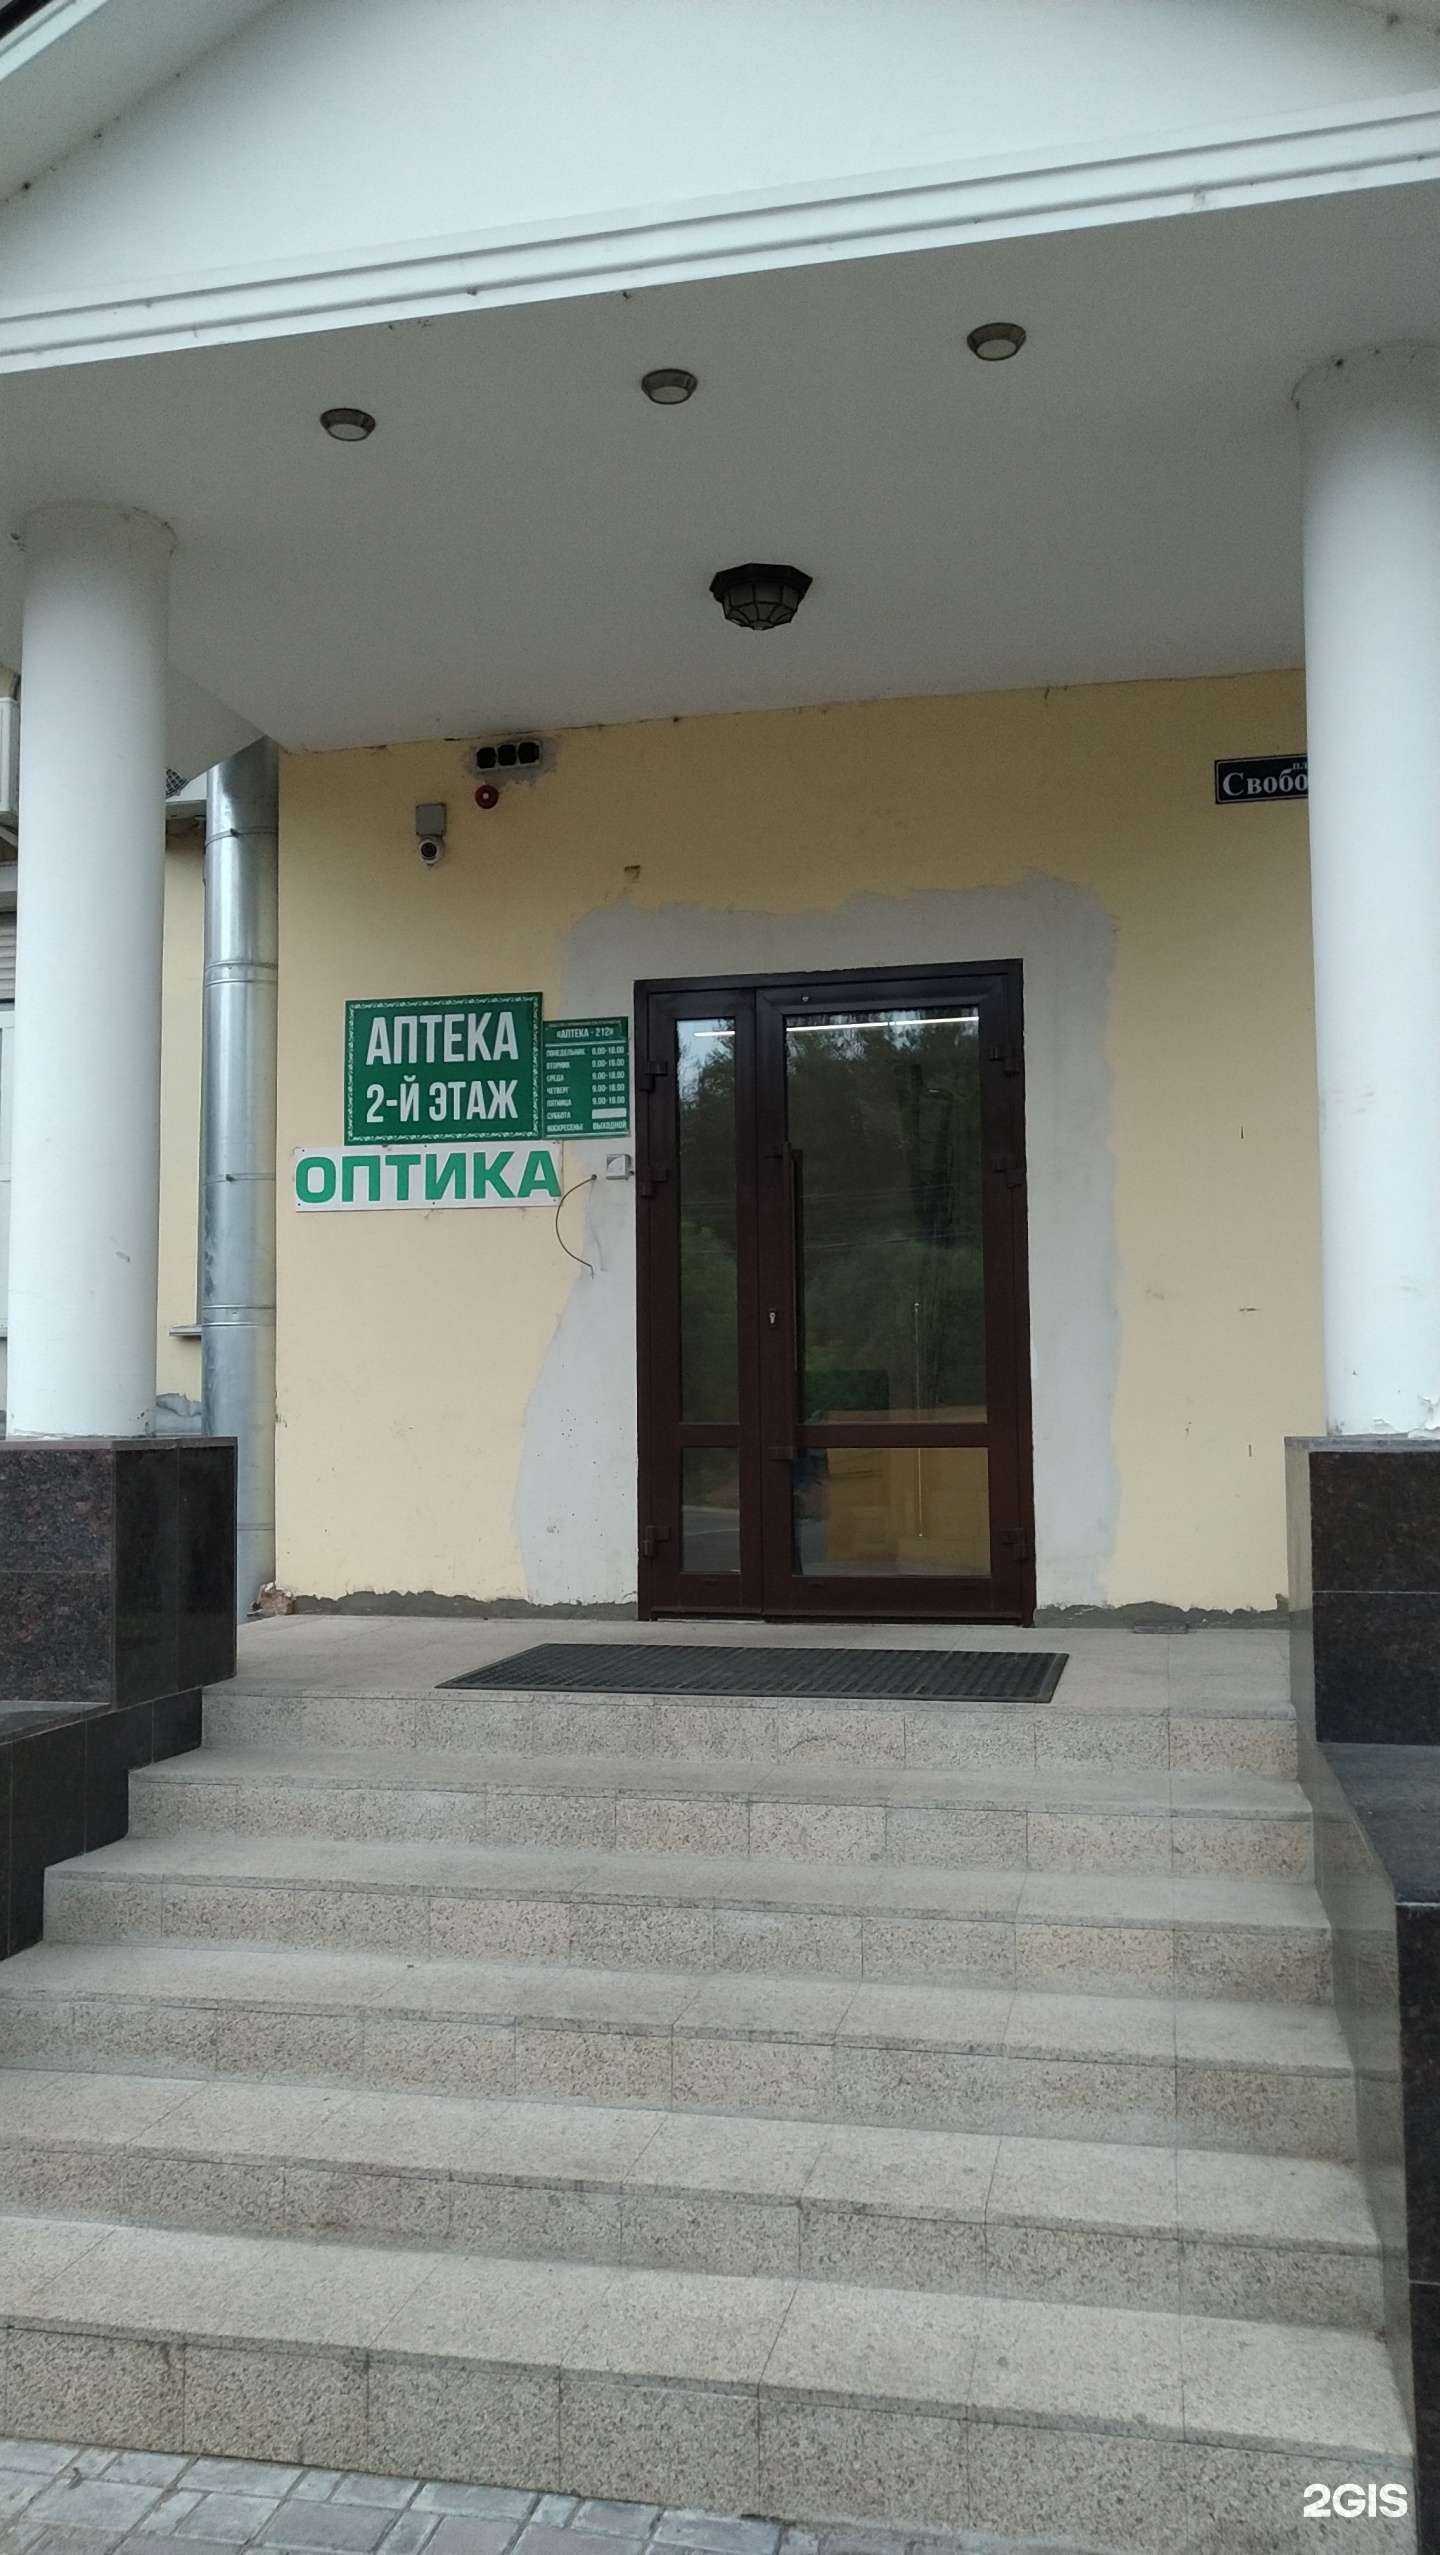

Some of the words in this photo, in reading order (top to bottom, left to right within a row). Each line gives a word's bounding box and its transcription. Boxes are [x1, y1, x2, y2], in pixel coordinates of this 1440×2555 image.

[366, 1011, 519, 1066] АПТЕКА
[366, 1075, 419, 1123] 2-Й
[429, 1079, 519, 1122] ЭТАЖ
[295, 1150, 561, 1203] ОПТИКА
